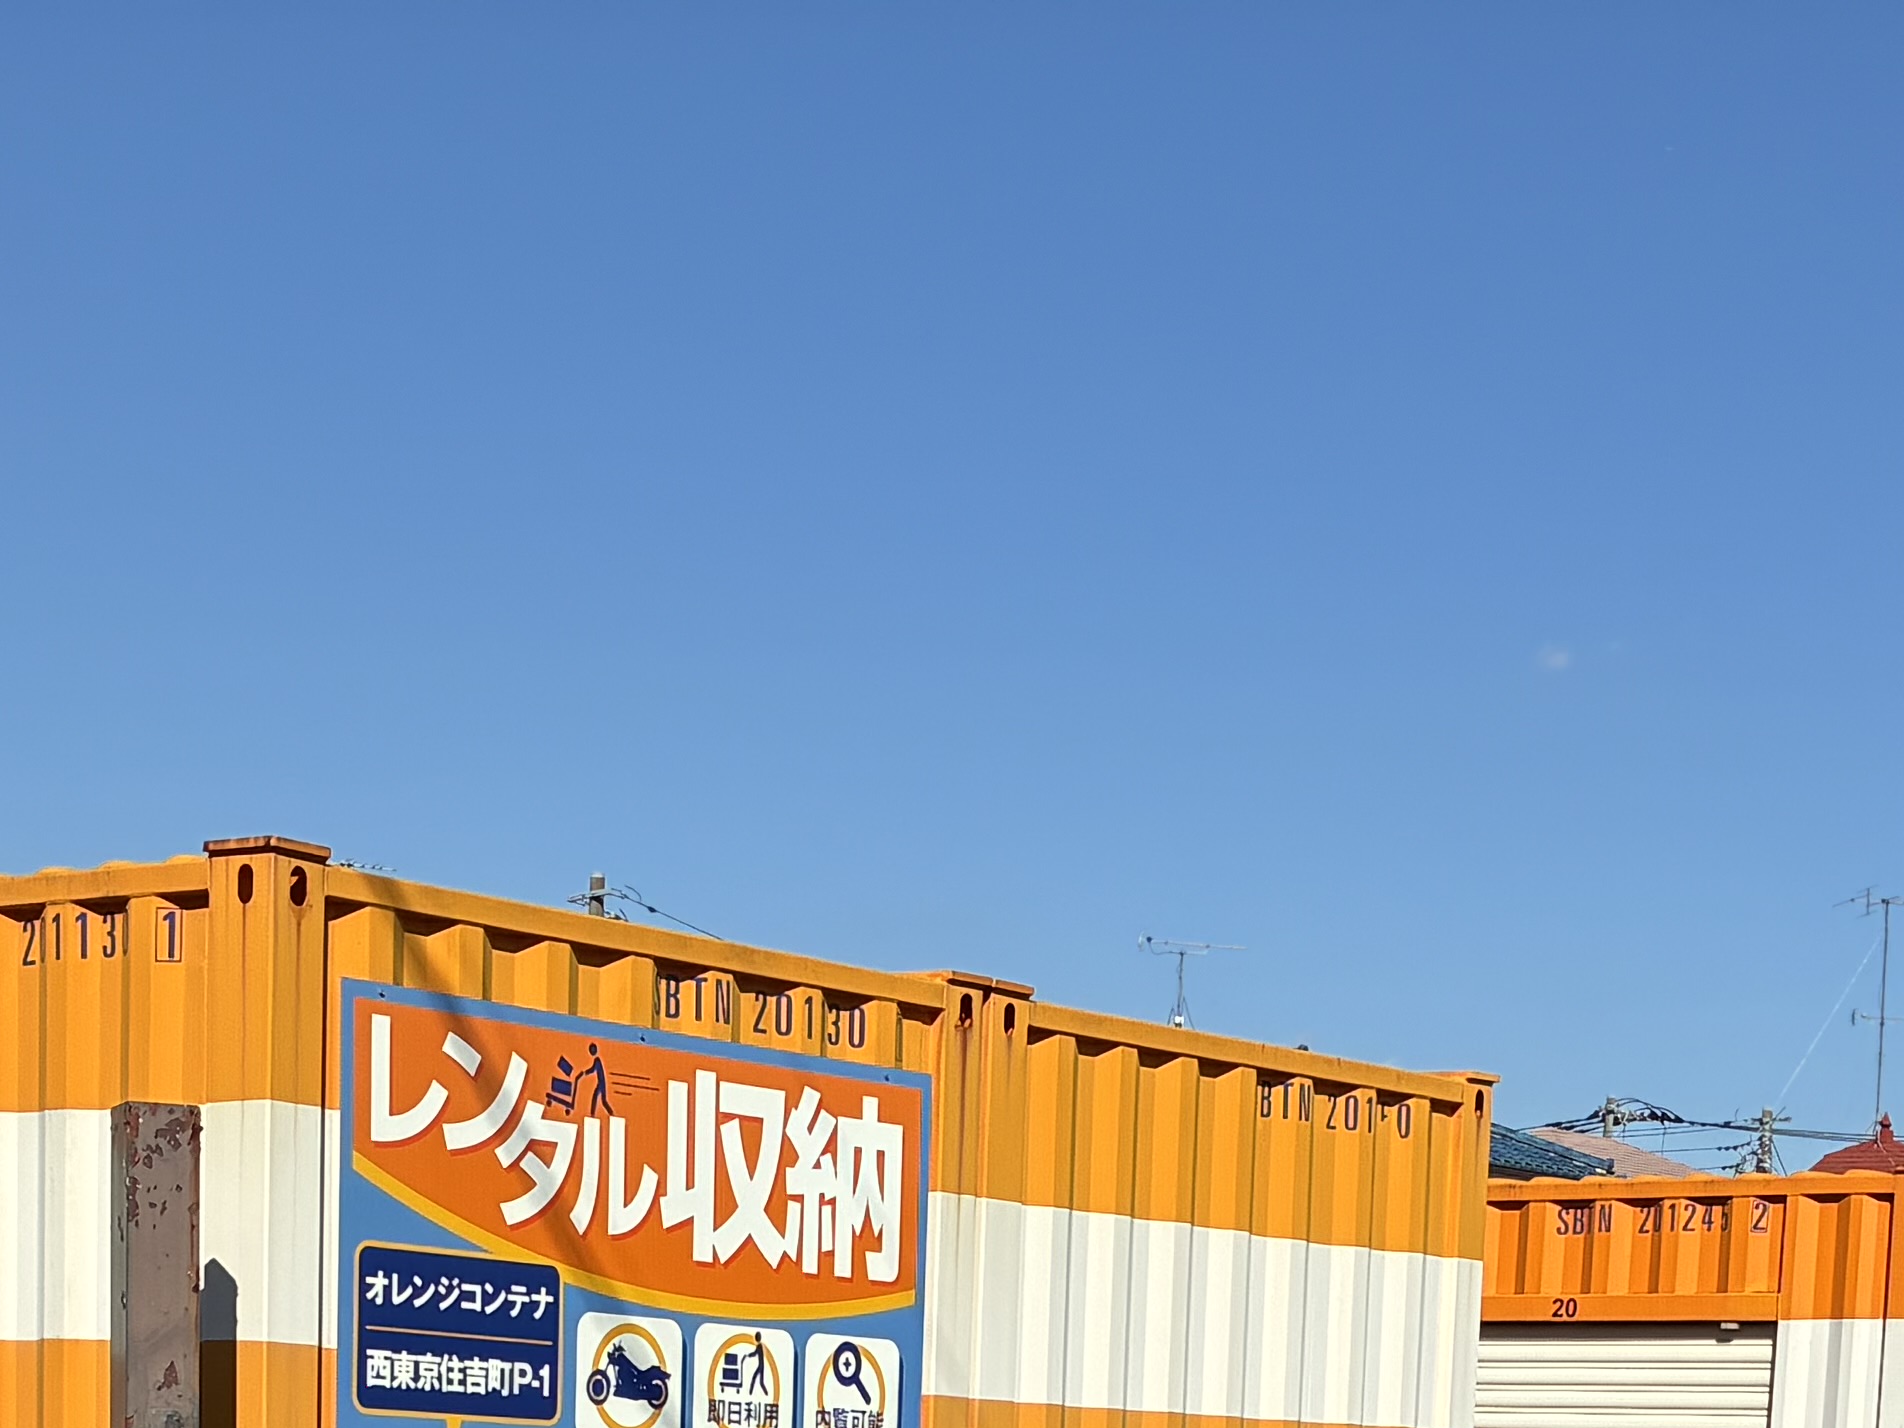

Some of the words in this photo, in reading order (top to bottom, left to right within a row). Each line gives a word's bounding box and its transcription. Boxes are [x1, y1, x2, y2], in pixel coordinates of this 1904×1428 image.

[371, 1012, 905, 1283] レンタル収納
[365, 1270, 555, 1321] オレンジコンテナ
[1551, 1298, 1578, 1318] 20
[365, 1349, 552, 1398] 西東京住吉町P-1
